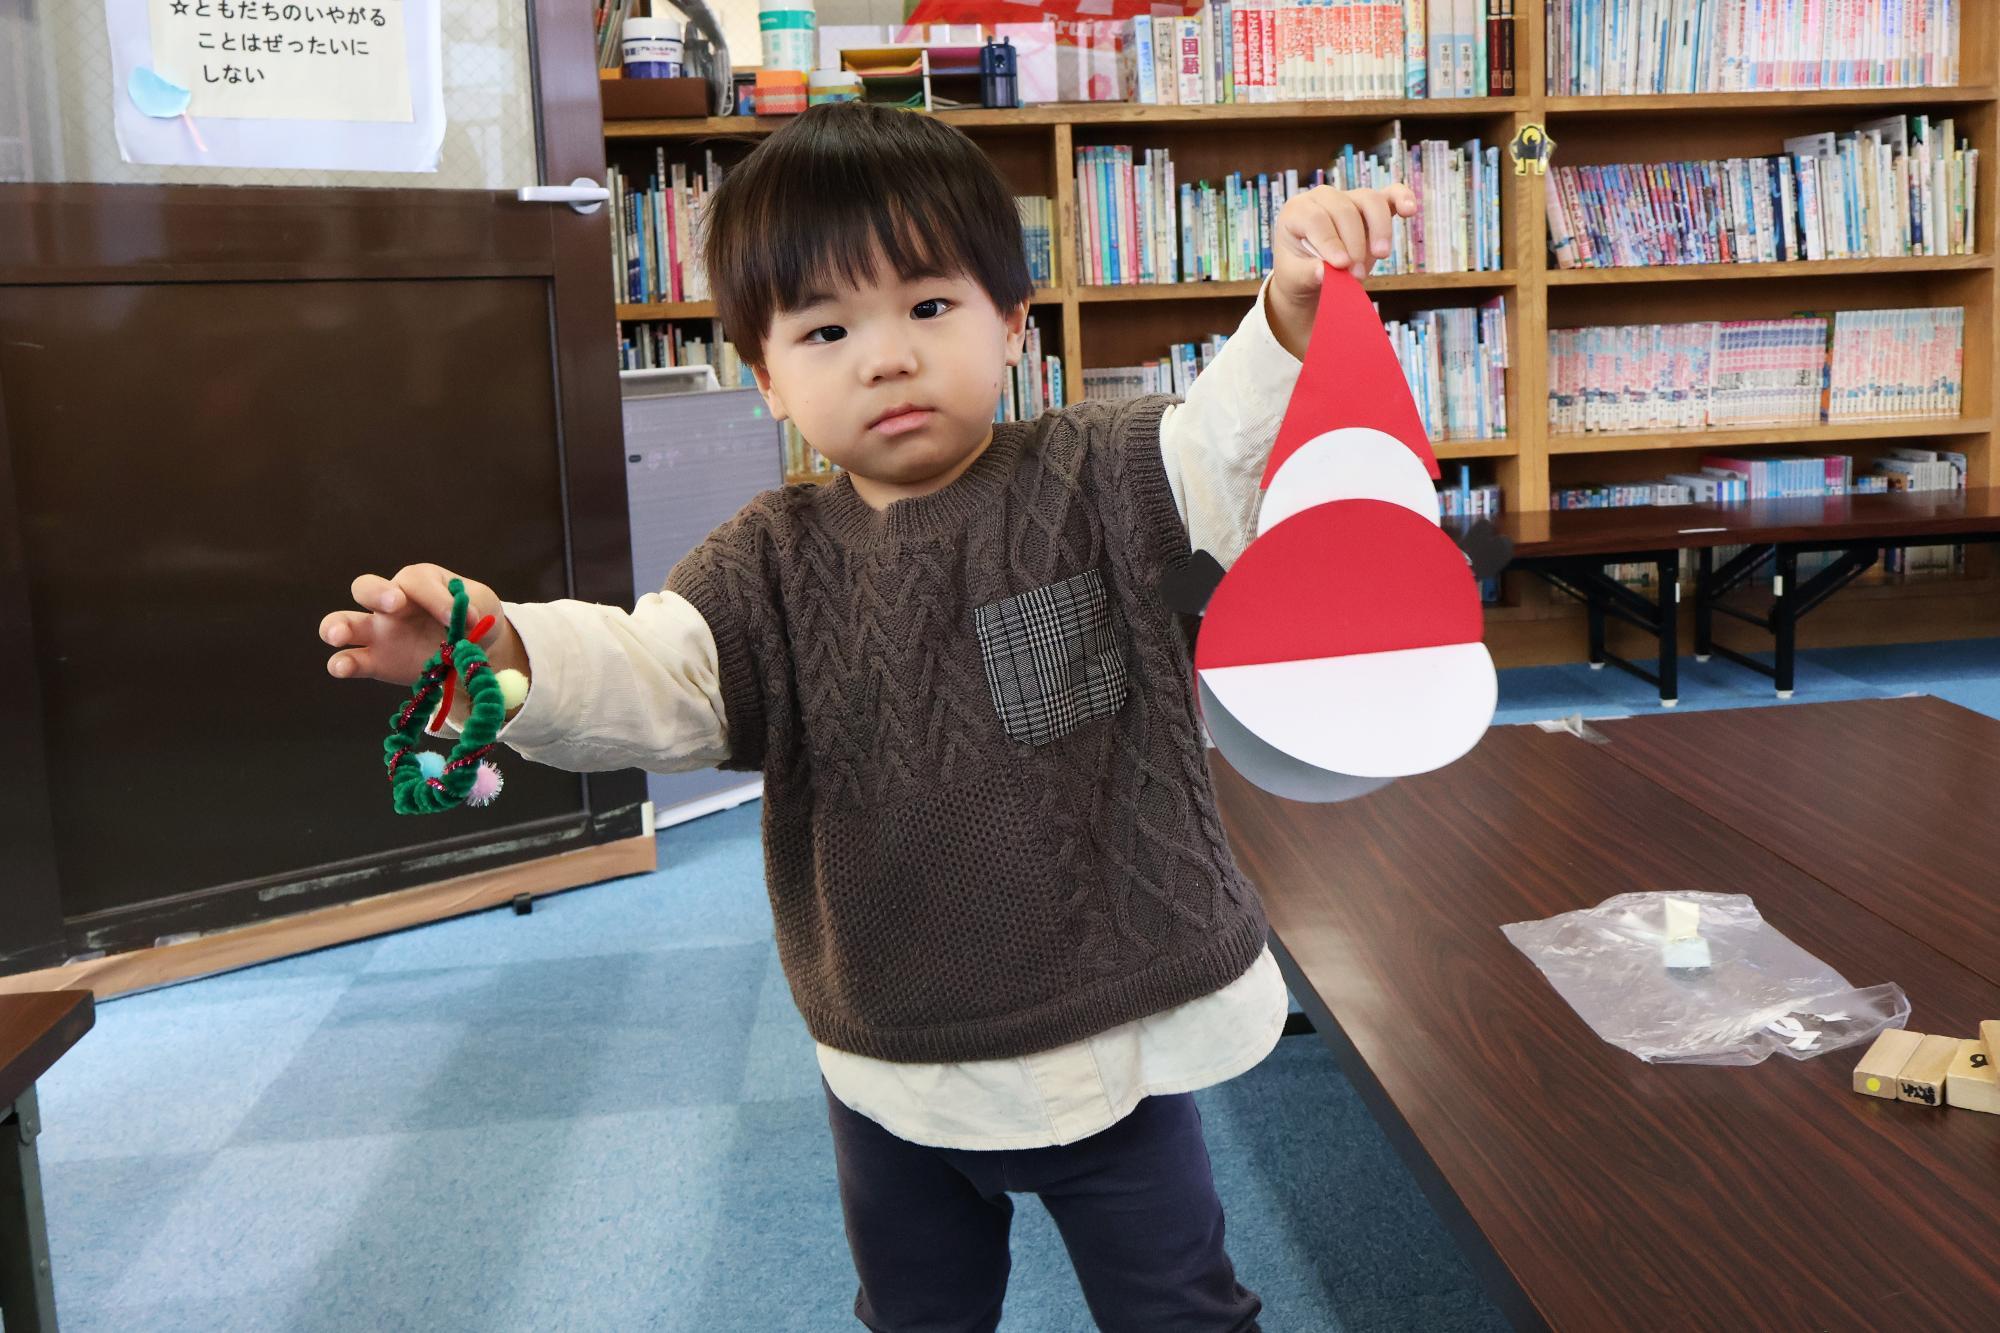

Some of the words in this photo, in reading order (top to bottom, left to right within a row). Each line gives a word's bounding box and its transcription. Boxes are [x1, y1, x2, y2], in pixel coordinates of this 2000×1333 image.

[195, 0, 386, 27] ともだちのいやがる
[198, 32, 370, 55] ことはぜったいに
[203, 64, 265, 84] しない
